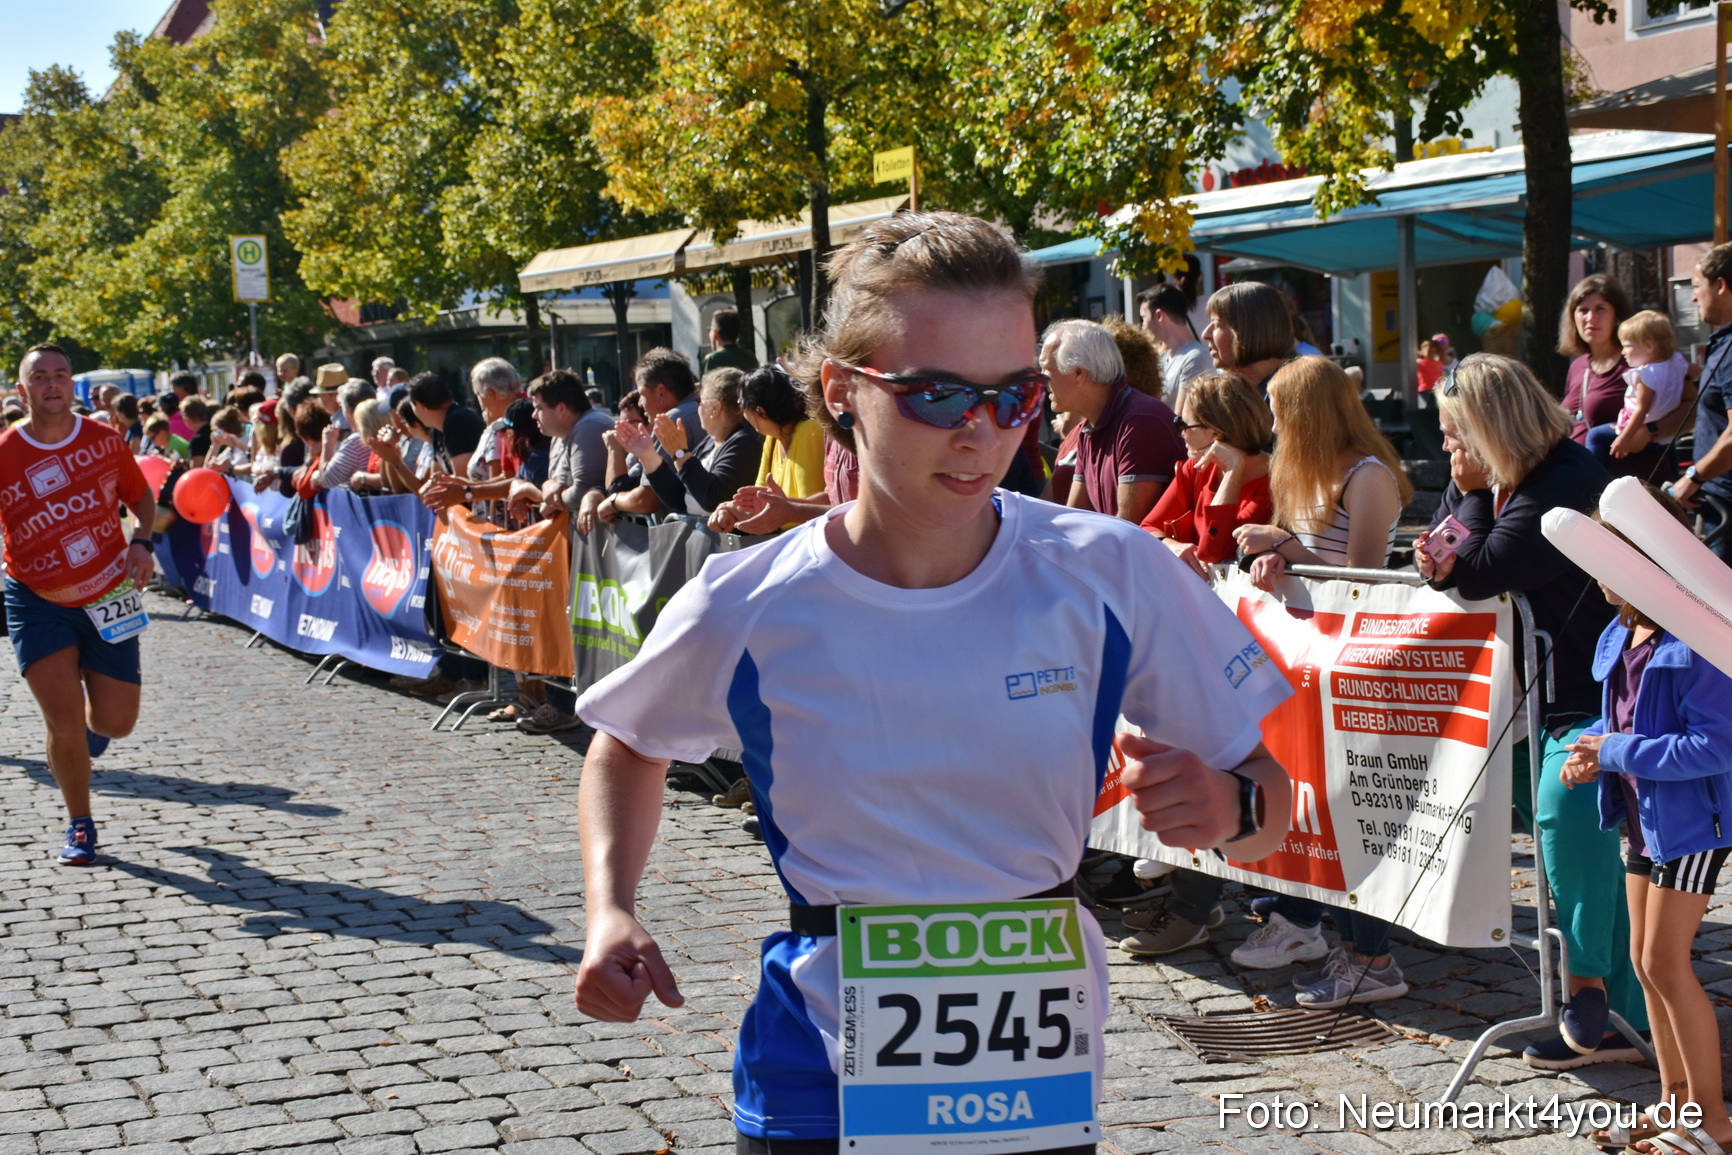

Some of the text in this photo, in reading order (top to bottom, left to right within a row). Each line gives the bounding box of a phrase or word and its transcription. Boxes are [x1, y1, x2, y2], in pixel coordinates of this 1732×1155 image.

[1338, 678, 1459, 702] RUNDSCHLINGEN
[1341, 711, 1439, 733] HEBEBÄNDER
[1346, 749, 1428, 771] Braun GmbH
[1350, 770, 1368, 787] Am
[1371, 772, 1430, 797] Grünberg
[1351, 791, 1403, 810] D-92318
[1357, 819, 1382, 837] Tel.
[1384, 821, 1413, 842] 09181
[1290, 841, 1305, 856] ist
[1362, 838, 1384, 857] Fax
[1386, 842, 1412, 864] 09181
[861, 909, 1076, 969] BOCK
[876, 987, 1071, 1067] 2545
[927, 1090, 1034, 1125] ROSA
